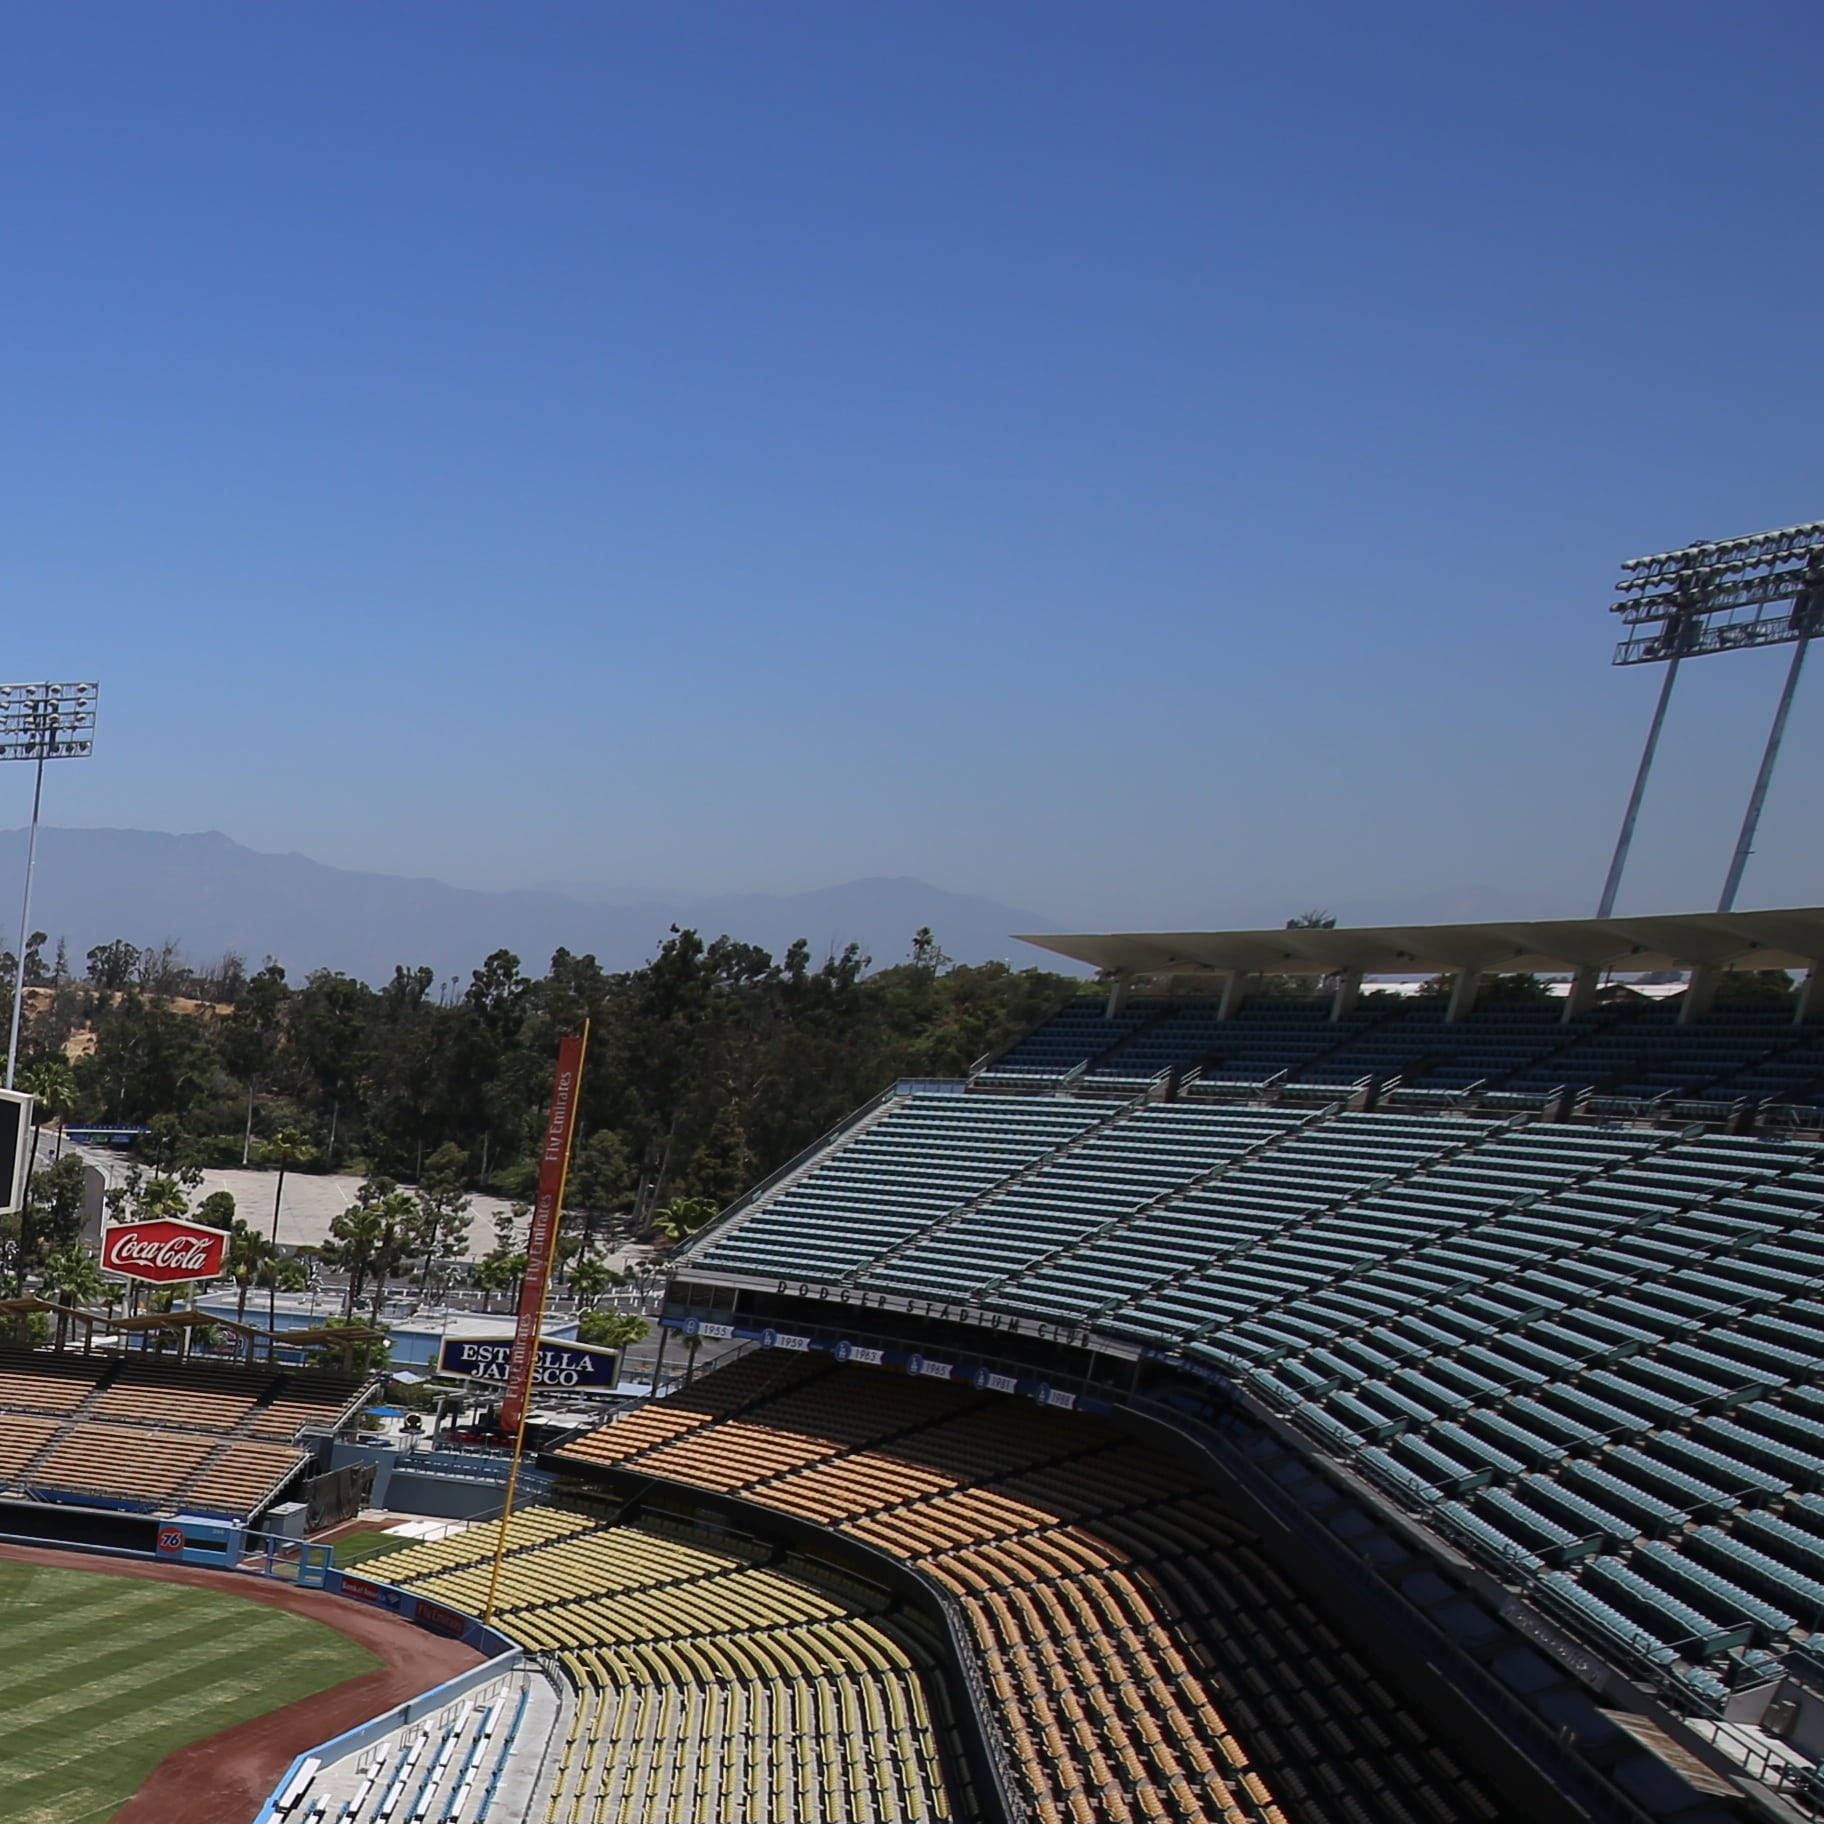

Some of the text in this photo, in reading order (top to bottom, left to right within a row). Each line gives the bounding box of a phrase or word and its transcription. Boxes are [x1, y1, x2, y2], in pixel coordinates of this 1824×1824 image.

[777, 1281, 1090, 1348] DODGER STADIUM CLUB
[704, 1324, 728, 1336] 1955
[781, 1337, 803, 1349] 1959
[162, 1532, 180, 1547] 76
